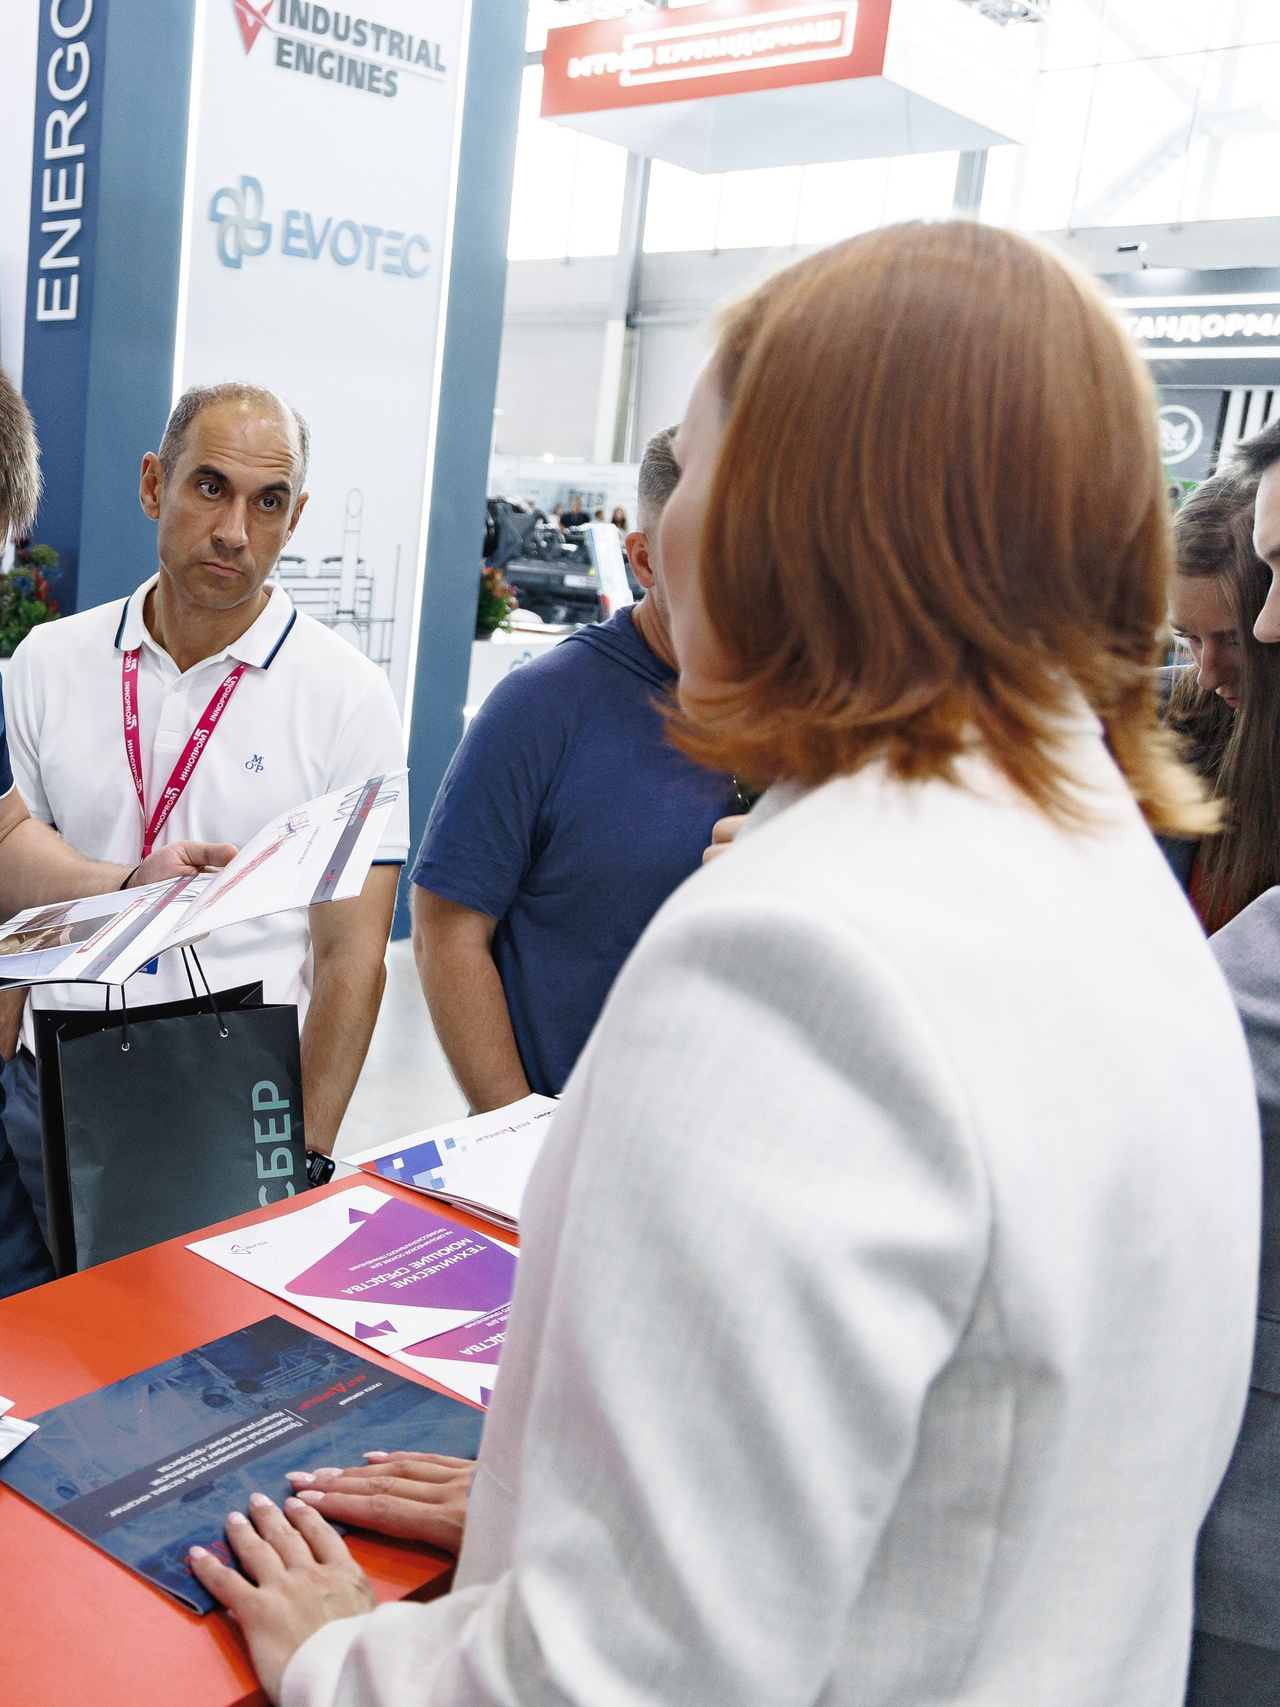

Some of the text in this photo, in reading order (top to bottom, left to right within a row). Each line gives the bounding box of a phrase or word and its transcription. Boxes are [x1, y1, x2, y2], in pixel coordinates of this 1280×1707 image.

[278, 0, 446, 72] INDUSTRIAL
[275, 37, 398, 97] ENGINES
[282, 209, 431, 278] EVOTEC
[210, 680, 236, 722] INNOPROM
[180, 734, 207, 781] ИННОПРОМ
[252, 754, 263, 765] M
[153, 792, 178, 833] INNOPROM
[339, 1236, 473, 1295] МОЮЩИЕ СРЕДСТВА
[387, 1242, 487, 1289] ТЕХНИЧЕСКИЕ
